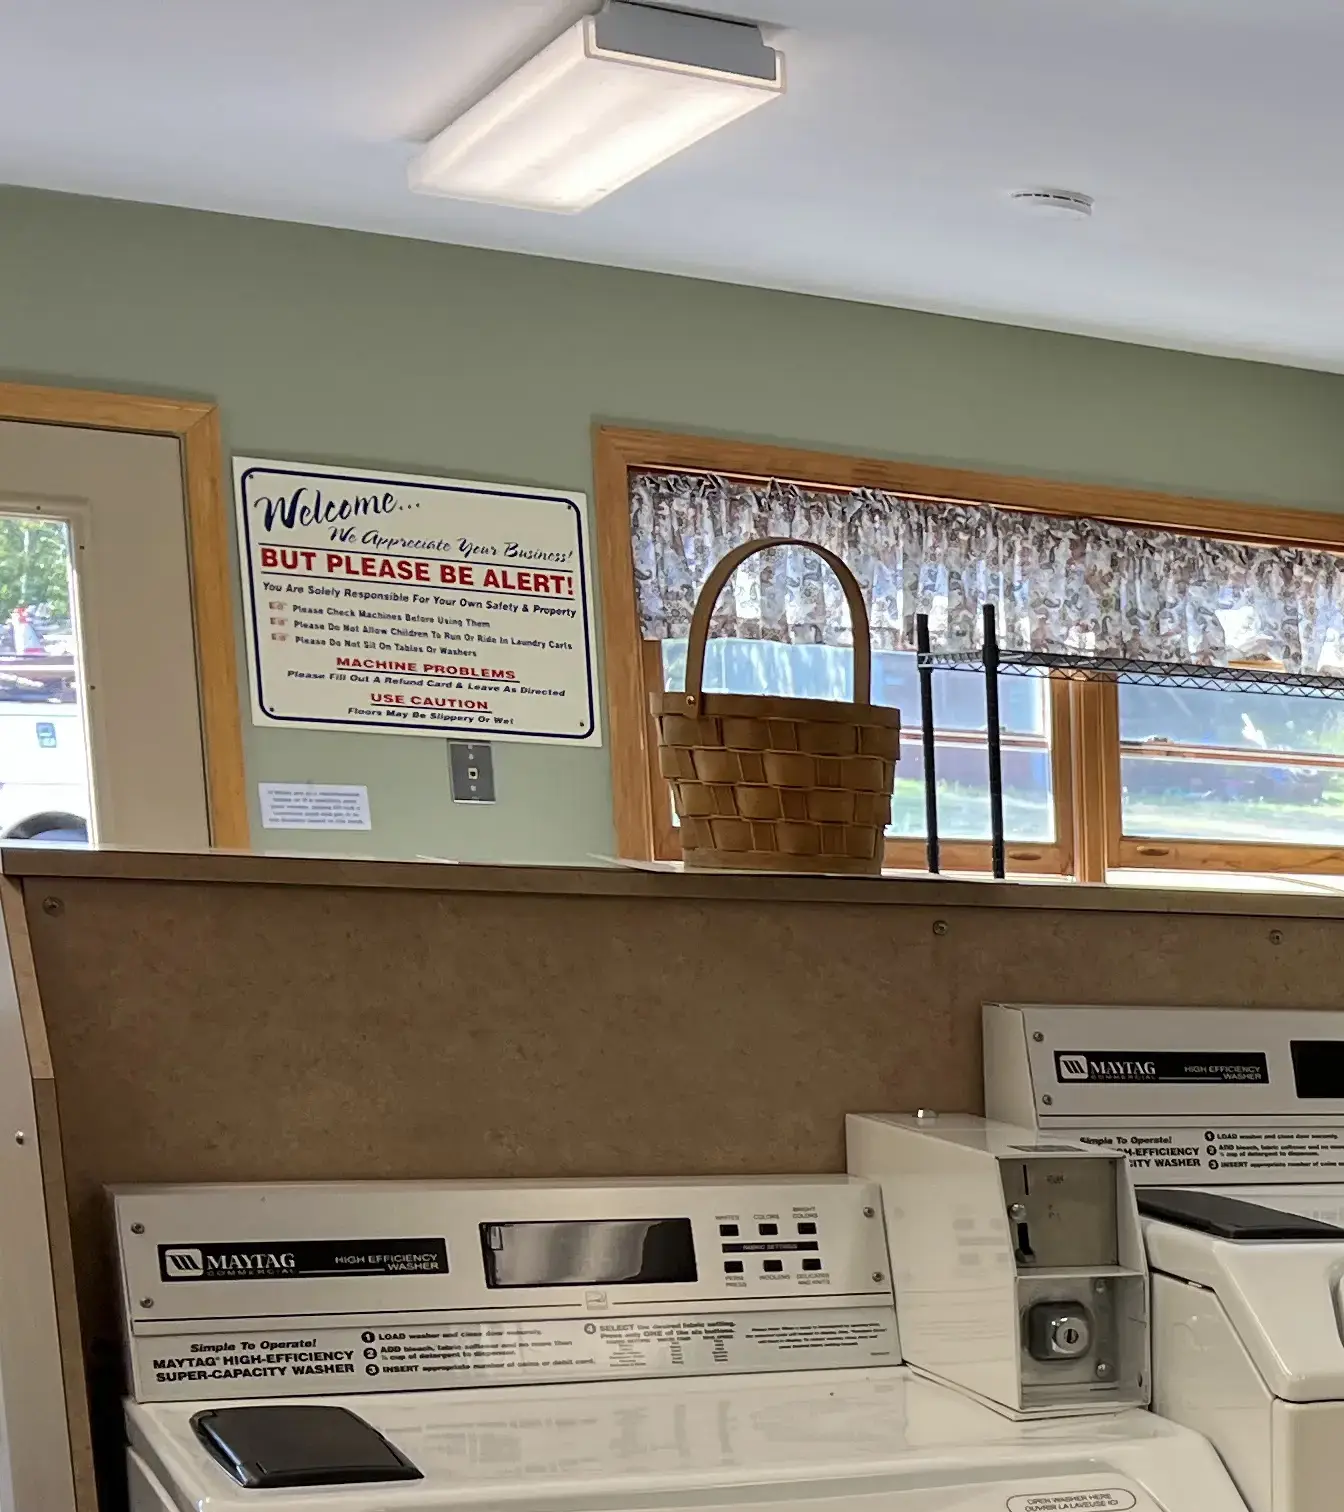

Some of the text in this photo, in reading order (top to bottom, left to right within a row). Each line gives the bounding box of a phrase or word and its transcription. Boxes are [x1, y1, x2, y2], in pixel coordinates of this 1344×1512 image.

[254, 487, 420, 532] Welcome...
[328, 525, 573, 563] We Appreciate Your Business!
[260, 547, 574, 595] BUT PLEASE BE ALERT!
[263, 581, 577, 618] You Are Solely Responsible For Your Own Safety & Property
[292, 604, 490, 628] Please Check Machines Before Using Them
[294, 620, 325, 630] Please
[328, 623, 341, 631] Do
[363, 625, 387, 635] Allow
[390, 627, 428, 638] Children
[431, 631, 442, 639] To
[444, 631, 461, 641] Run
[464, 633, 475, 642] Or
[477, 635, 497, 644] Ride
[500, 636, 509, 644] In
[511, 637, 546, 649] Laundry
[548, 640, 573, 650] Carts
[295, 636, 326, 646] Please
[329, 639, 341, 647] Do
[344, 640, 360, 648] Not
[378, 642, 392, 651] On
[394, 643, 423, 653] Tables
[426, 646, 437, 654] Or
[439, 647, 477, 657] Washers
[336, 657, 516, 680] MACHINE PROBLEMS
[287, 670, 325, 679] Please
[329, 673, 346, 681] Fill
[350, 674, 369, 683] Out
[372, 676, 381, 684] A
[384, 677, 424, 687] Refund
[426, 679, 453, 688] Card
[467, 682, 500, 692] Leave
[503, 685, 517, 693] As
[520, 686, 565, 697] Directed
[371, 693, 488, 710] USE CAUTION
[348, 707, 383, 716] Floors
[386, 709, 408, 719] May
[429, 712, 474, 723] Slippery
[477, 715, 491, 723] Or
[494, 716, 514, 725] Wet
[1090, 1061, 1156, 1075] MAYTAG
[1208, 1065, 1260, 1073] EFFICIENCY
[1130, 1136, 1172, 1145] Operate!
[1155, 1158, 1201, 1168] WASHER
[206, 1253, 438, 1270] MAYTAG HIGH EFFICIENCY
[387, 1261, 439, 1271] WASHER
[190, 1339, 317, 1353] Simple To Operate!
[378, 1333, 406, 1341] LOAD
[223, 1350, 354, 1366] HIGH-EFFICIENCY
[156, 1363, 354, 1383] SUPER-CAPACITY WASHER
[383, 1365, 419, 1373] INSERT
